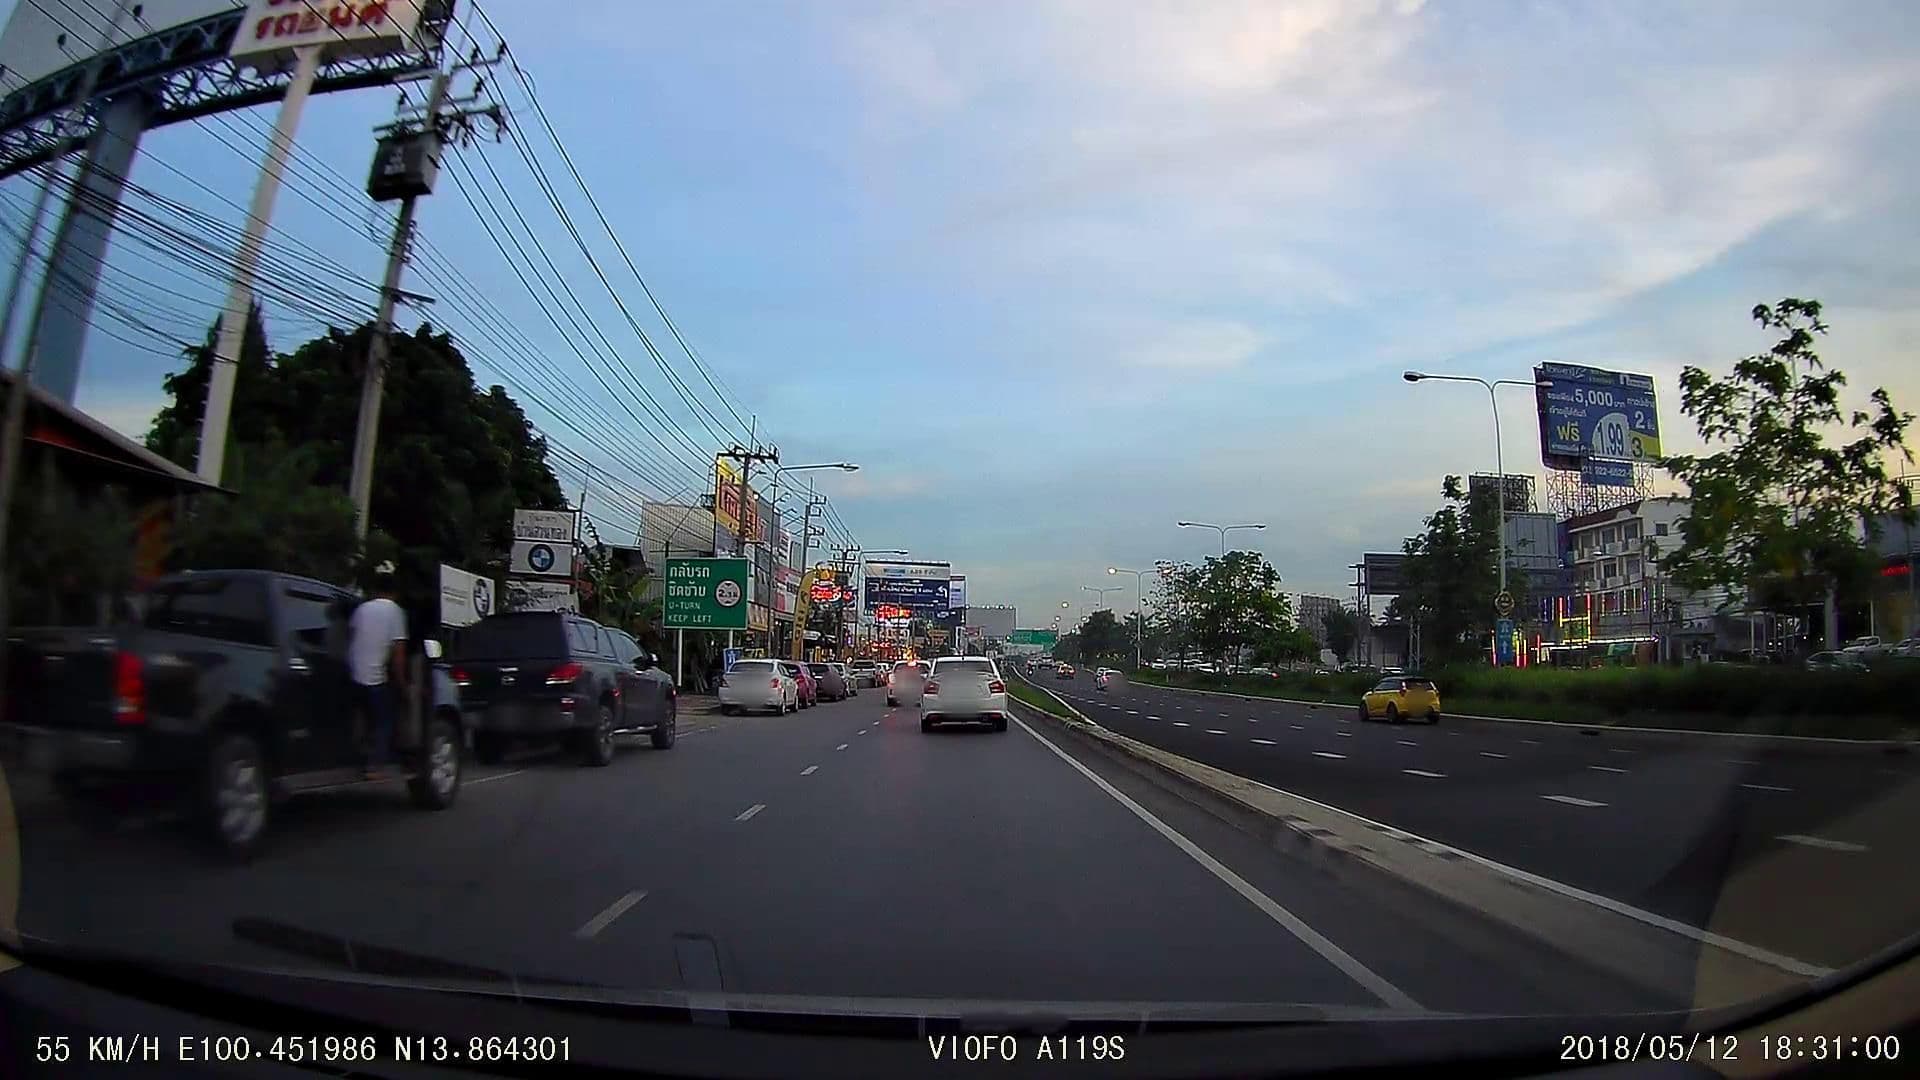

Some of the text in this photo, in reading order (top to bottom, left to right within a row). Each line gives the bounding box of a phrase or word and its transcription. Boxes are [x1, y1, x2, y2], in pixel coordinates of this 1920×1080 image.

[1575, 388, 1614, 408] 5,000
[1557, 421, 1581, 442] ฟรี
[1597, 421, 1625, 457] 1.99
[670, 562, 710, 578] กลับรถ
[668, 581, 706, 597] ชิดซ้าย
[668, 601, 701, 610] U-TURN
[668, 614, 712, 623] KEEP LEFT
